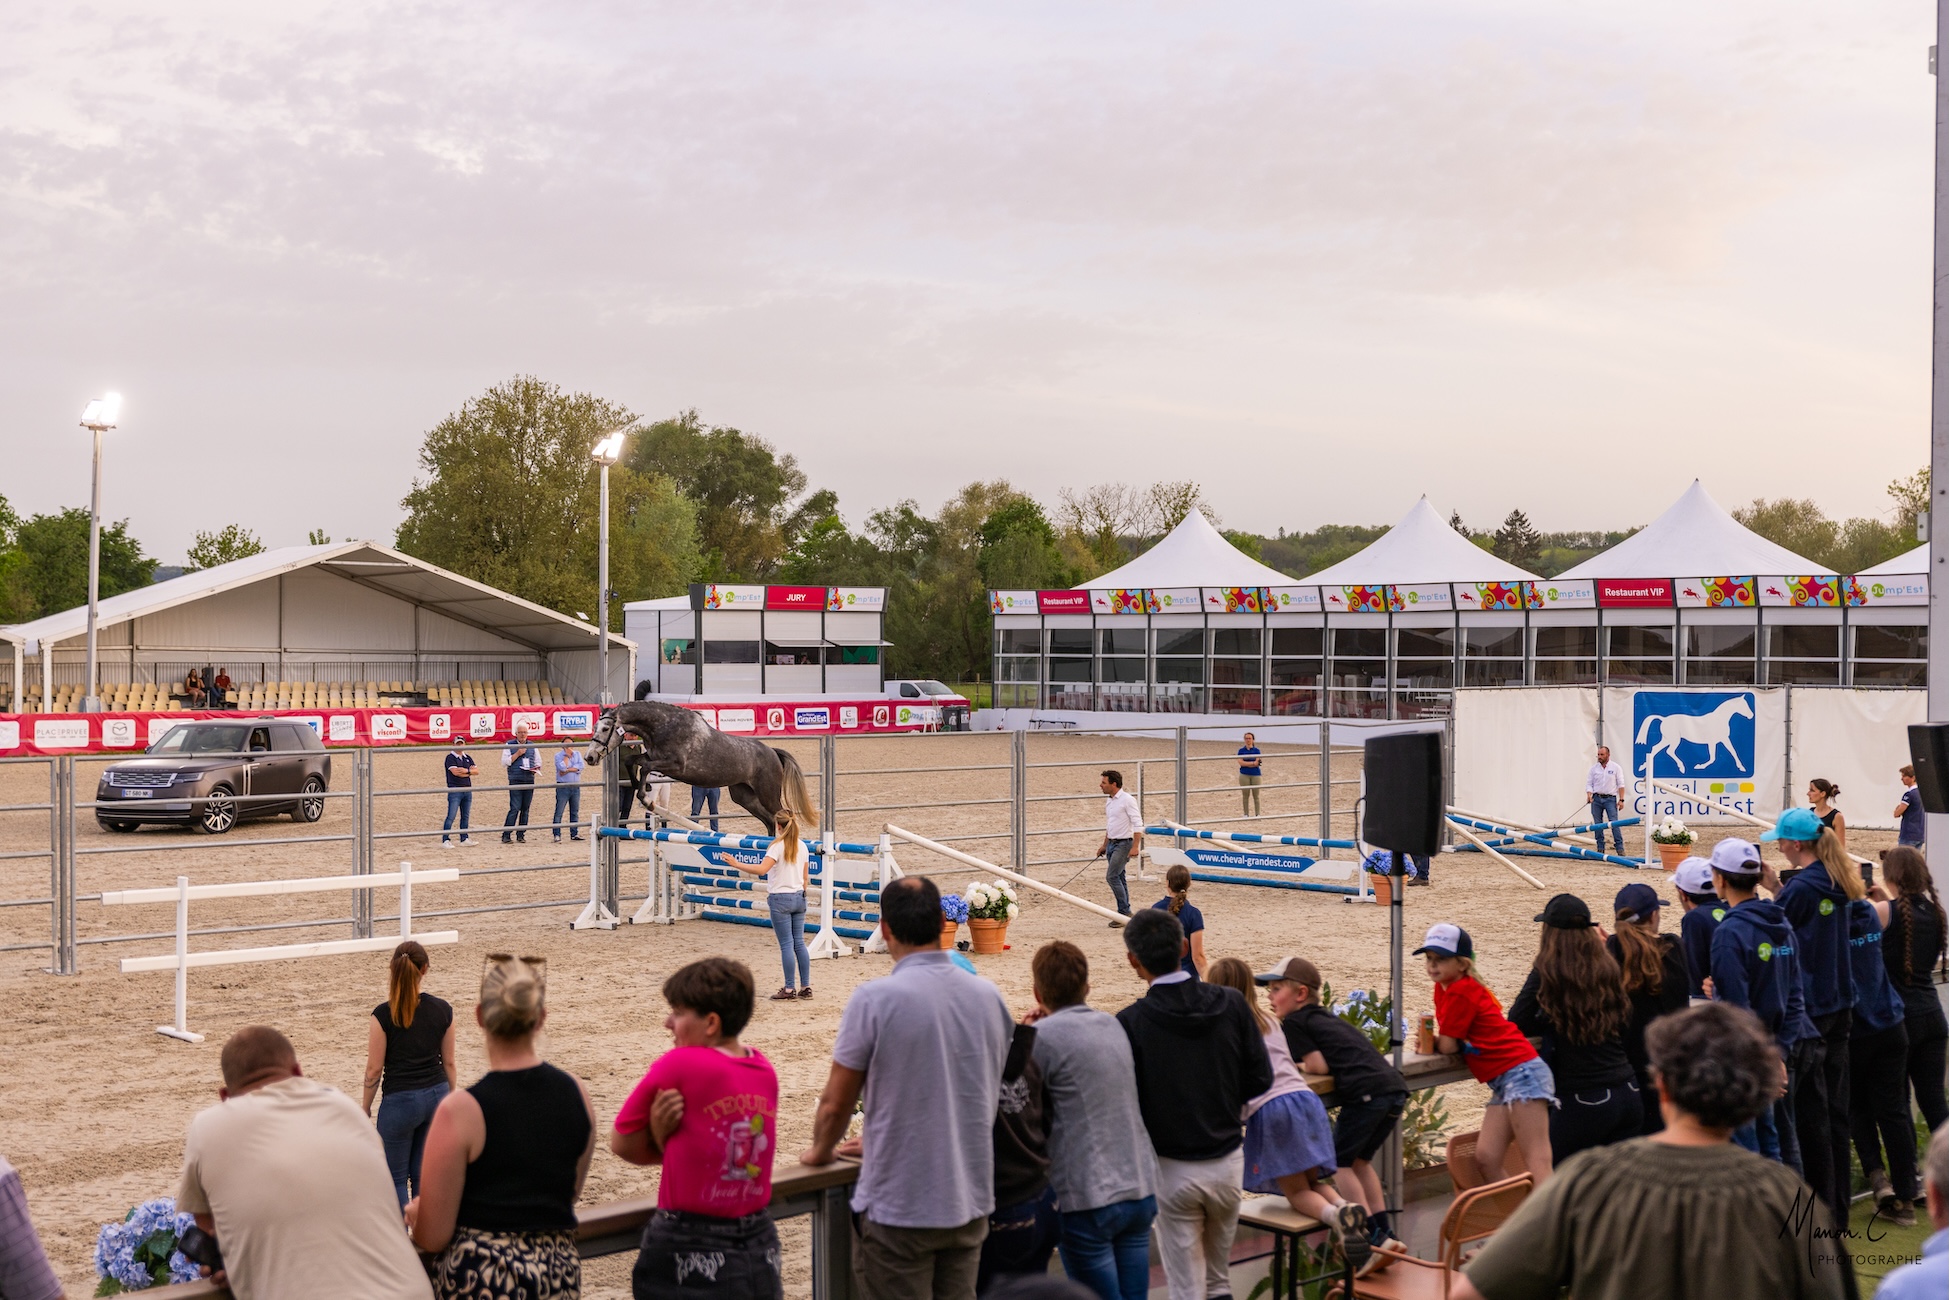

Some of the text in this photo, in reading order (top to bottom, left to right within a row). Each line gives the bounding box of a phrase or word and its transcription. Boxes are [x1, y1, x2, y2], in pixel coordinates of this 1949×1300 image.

[1408, 592, 1447, 602] Jump'Est
[1547, 590, 1591, 600] Jump'Est
[1605, 587, 1665, 597] Restaurant VIP
[786, 593, 807, 602] JURY
[1043, 597, 1084, 605] Restaurant VIP
[561, 716, 586, 725] TRYBA
[377, 728, 402, 736] visconti
[1198, 853, 1300, 868] www.cheval-grandest.com
[703, 1093, 776, 1120] TEQUIL
